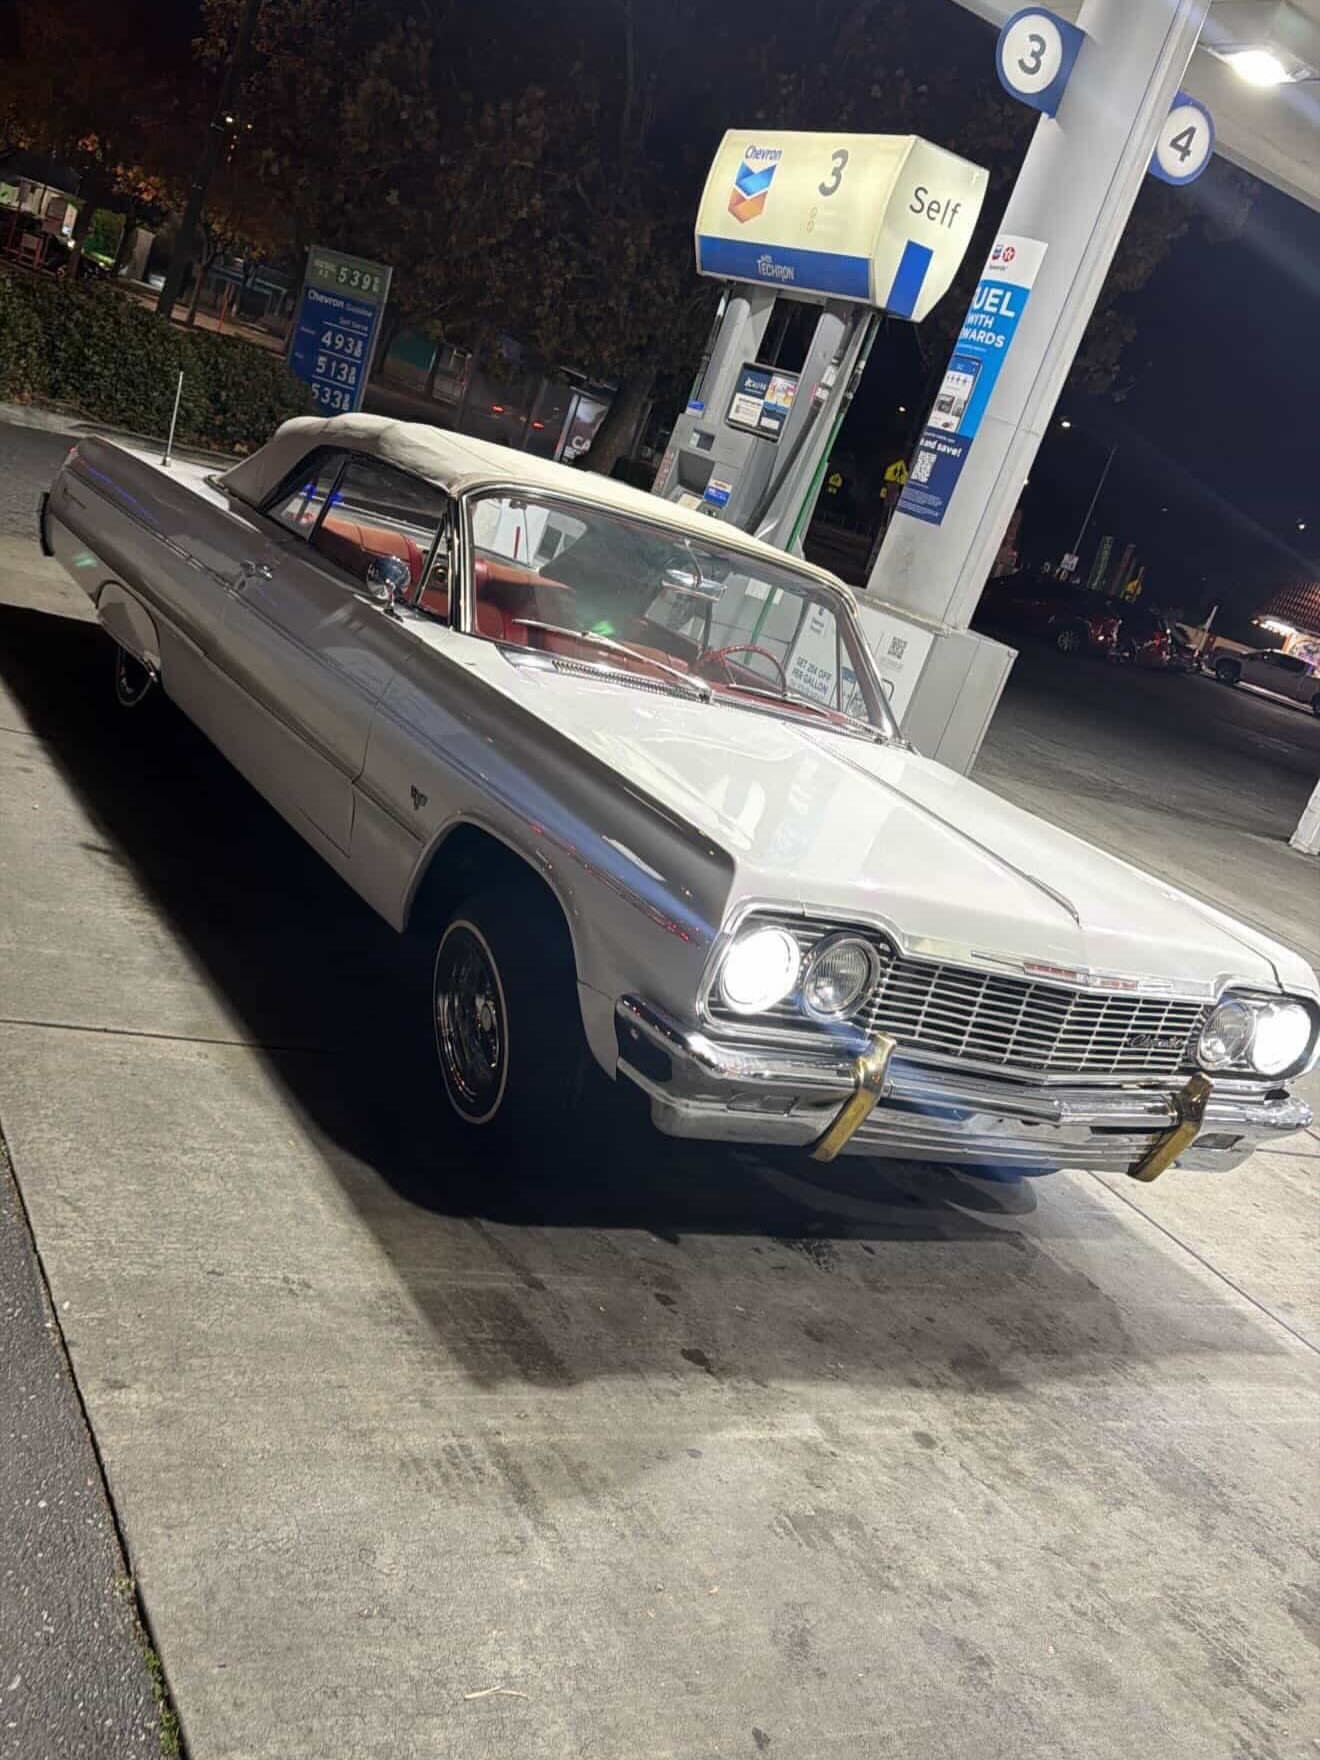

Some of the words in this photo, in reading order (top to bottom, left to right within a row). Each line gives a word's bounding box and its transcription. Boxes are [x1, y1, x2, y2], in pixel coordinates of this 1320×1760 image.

[1017, 33, 1047, 75] 3
[744, 144, 783, 161] Chevron
[1168, 125, 1197, 163] 4
[817, 148, 849, 197] 3
[909, 186, 962, 229] Self
[307, 288, 345, 309] Chevron
